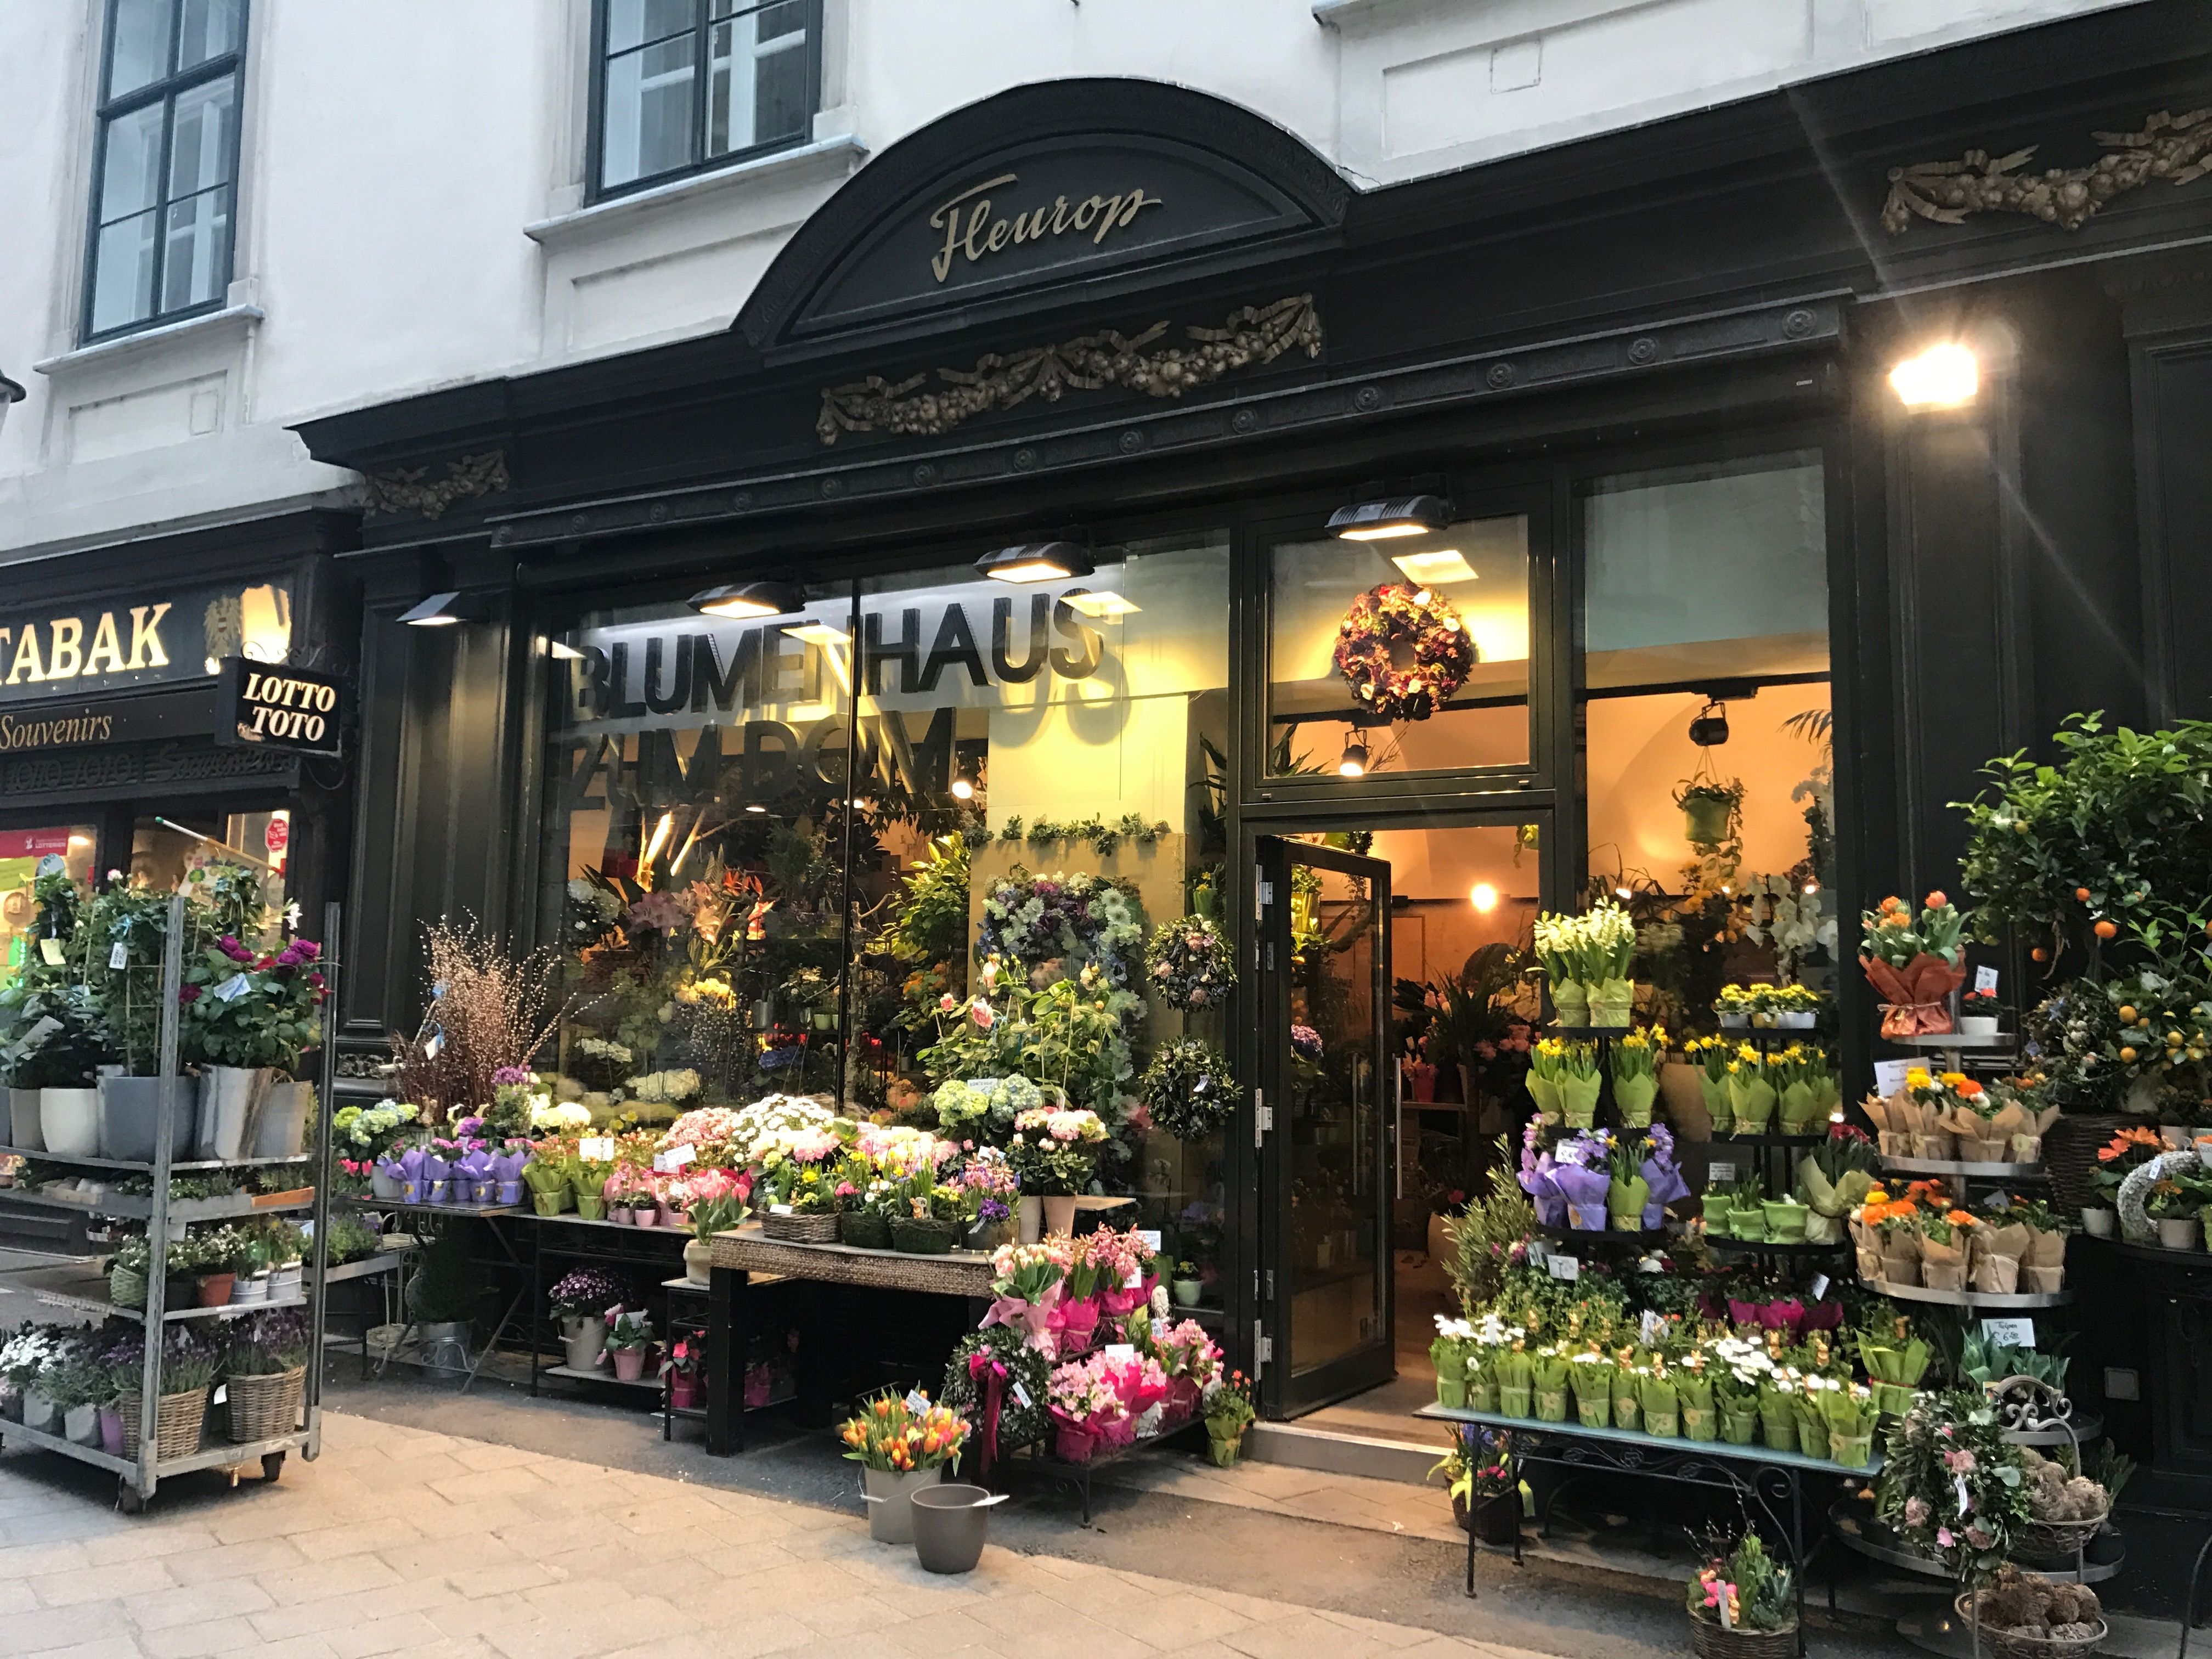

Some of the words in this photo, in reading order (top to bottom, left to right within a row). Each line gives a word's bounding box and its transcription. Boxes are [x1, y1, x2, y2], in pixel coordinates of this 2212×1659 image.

[929, 173, 1164, 283] Fleurop
[568, 586, 1104, 722] BLUMENHAUS
[242, 673, 336, 712] LOTTO
[0, 708, 112, 750] Souvenirs
[251, 706, 325, 742] TOTO
